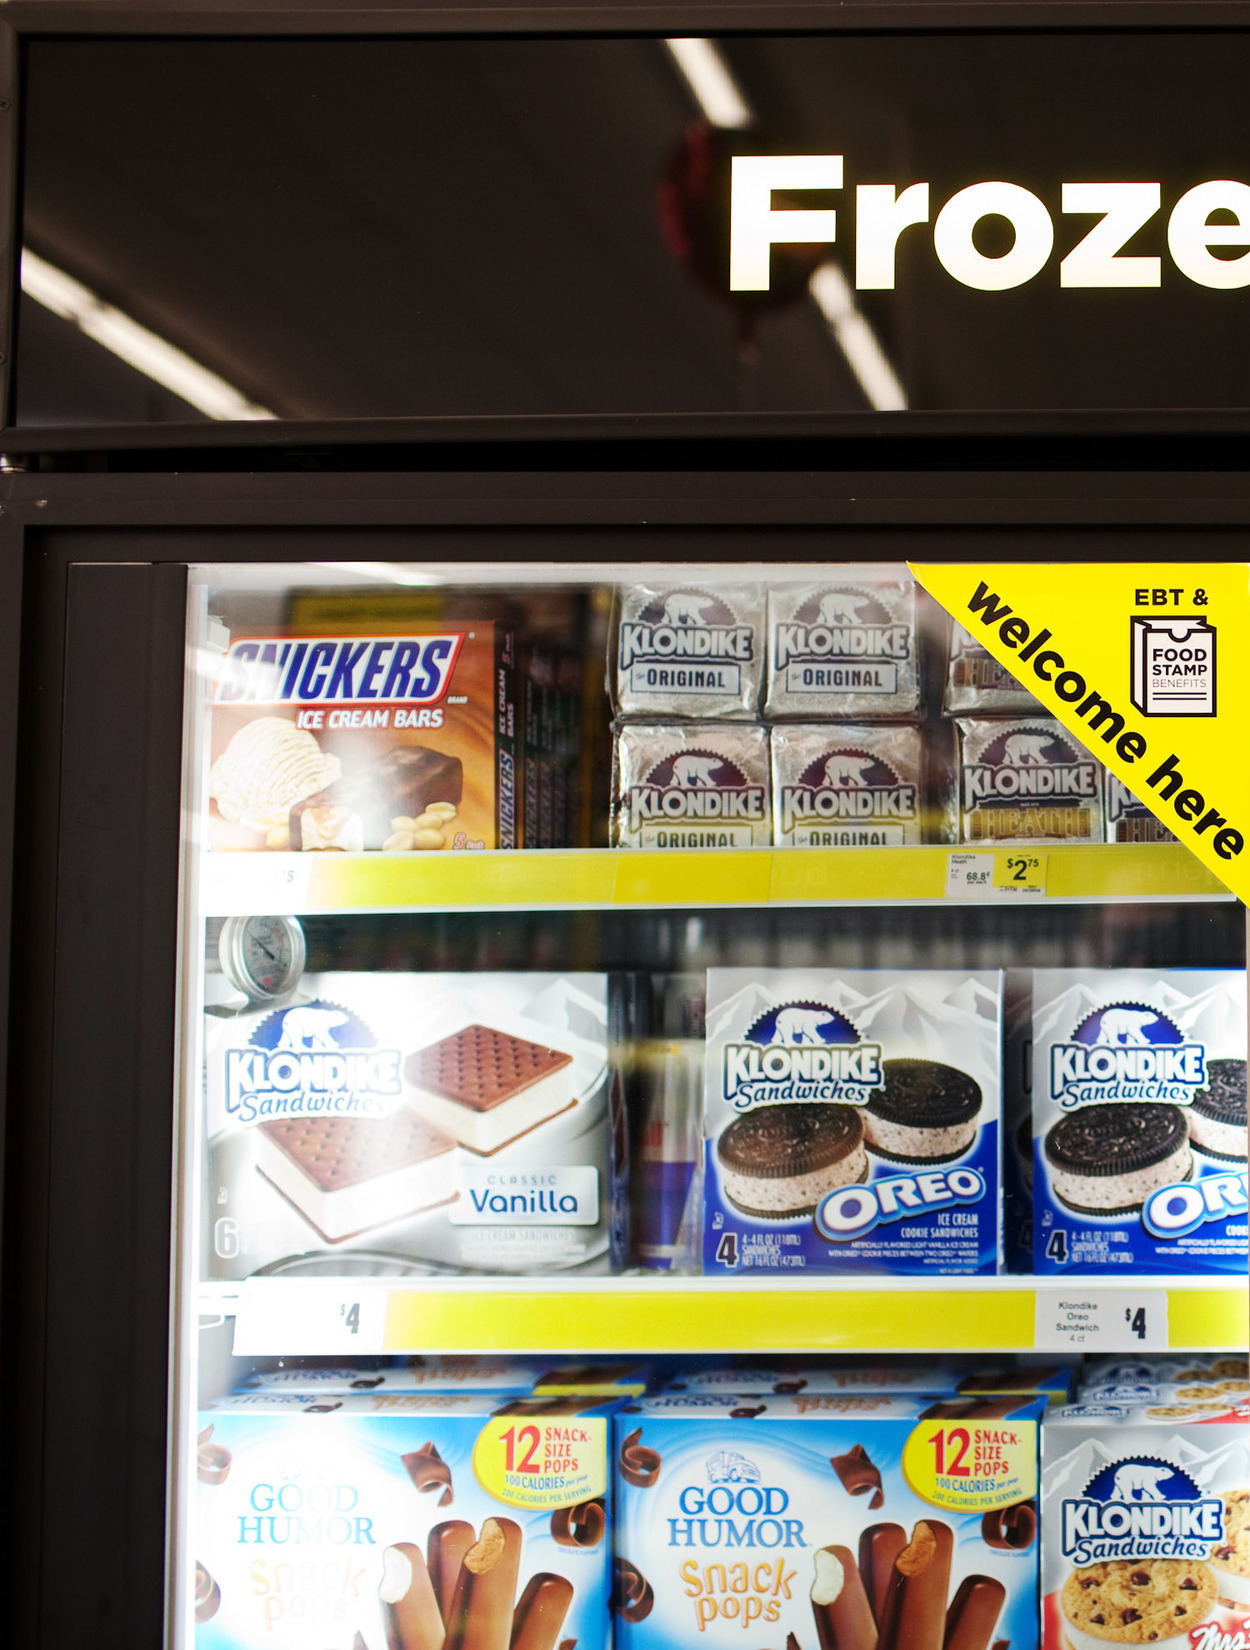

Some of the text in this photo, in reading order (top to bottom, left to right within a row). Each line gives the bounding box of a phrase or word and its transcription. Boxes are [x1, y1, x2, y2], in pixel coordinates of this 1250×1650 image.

[1135, 588, 1209, 606] EBT &
[622, 625, 752, 668] KLONDIKE
[777, 626, 908, 668] KLONDIKE
[1152, 648, 1207, 662] FOOD
[219, 639, 453, 700] SNICKERS
[647, 668, 726, 687] ORIGINAL
[803, 667, 882, 687] ORIGINAL
[1152, 664, 1208, 677] STAMP
[1152, 679, 1207, 688] BENEFITS
[297, 708, 444, 729] ICE CREAM BARS
[967, 581, 1245, 860] welcome here
[500, 752, 514, 849] SNICKERS
[964, 764, 1096, 813] KLONDIKE
[630, 787, 764, 831] KLONDIKE
[782, 787, 916, 831] KLONDIKE
[986, 808, 1076, 838] HEATH
[656, 831, 737, 847] ORIGINAL
[809, 831, 888, 846] ORIGINAL
[229, 1051, 400, 1112] KLONDIKE
[726, 1046, 880, 1095] KLONDIKE
[1053, 1046, 1203, 1094] KLONDIKE
[239, 1090, 384, 1122] Sandwiches
[736, 1080, 868, 1107] Sandwiches
[1061, 1080, 1191, 1107] Sandwiches
[486, 1175, 557, 1186] CLASSIC
[470, 1189, 578, 1213] Vanilla
[822, 1169, 982, 1232] OREO
[900, 1227, 979, 1238] COOKIE SANDWICHES
[937, 1213, 979, 1226] ICE CREAM
[214, 1217, 239, 1258] 6
[716, 1232, 739, 1268] 4
[1046, 1230, 1069, 1264] 4
[340, 1301, 361, 1335] $4
[1058, 1301, 1098, 1310] Klondike
[1067, 1313, 1089, 1321] Oreo
[1056, 1323, 1100, 1332] Sandwich
[1125, 1307, 1146, 1340] $4
[499, 1425, 541, 1474] 12
[544, 1444, 572, 1458] SIZE
[974, 1430, 1022, 1445] SNACK-
[928, 1427, 971, 1477] 12
[974, 1446, 1002, 1460] SIZE
[544, 1459, 579, 1474] POPS
[974, 1461, 1009, 1477] POPS
[505, 1475, 565, 1490] 100 CALORIES
[936, 1478, 996, 1493] 100 CALORIES
[250, 1483, 359, 1512] GOOD
[516, 1492, 548, 1504] CALORIES
[679, 1486, 789, 1515] GOOD
[947, 1495, 978, 1506] CALORIES
[237, 1516, 376, 1545] HUMOR
[666, 1518, 808, 1548] HUMOR
[1064, 1502, 1222, 1554] KLONDIKE
[1073, 1536, 1208, 1564] Sandwiches
[679, 1557, 798, 1600] Snack
[694, 1595, 782, 1632] pops
